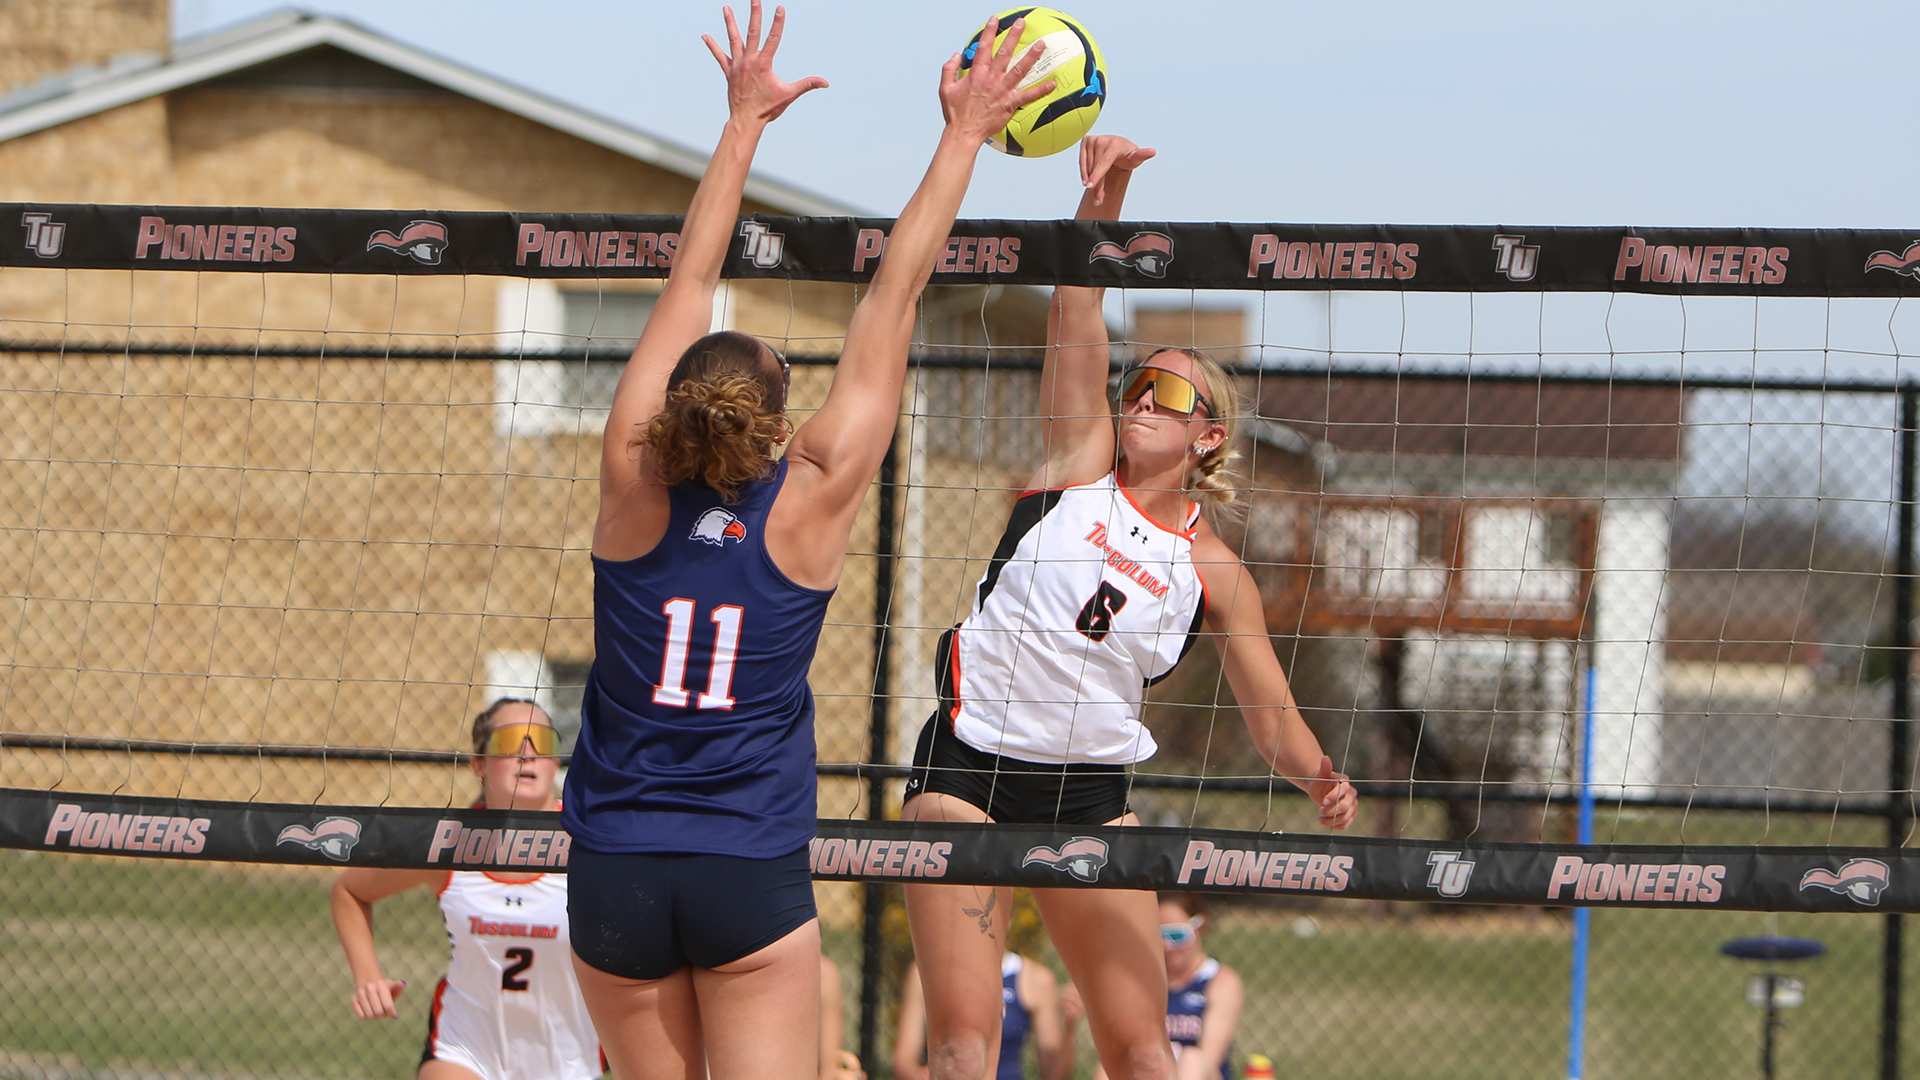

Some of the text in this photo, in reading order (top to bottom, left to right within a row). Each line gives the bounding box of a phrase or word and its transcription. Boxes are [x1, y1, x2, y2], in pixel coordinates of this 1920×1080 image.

[22, 212, 66, 258] TU
[135, 216, 297, 262] PIONEERS
[516, 223, 680, 268] PIONEERS
[740, 221, 785, 269] TU
[853, 228, 1021, 273] PEERS
[1247, 233, 1419, 280] PIONEERS
[1492, 234, 1541, 282] TU
[1614, 236, 1790, 284] PIONEERS
[1075, 580, 1128, 642] 6
[652, 597, 745, 711] 11
[44, 804, 211, 854] PIONEERS
[427, 819, 572, 866] PIONEER
[809, 836, 953, 878] IONEERS
[1177, 840, 1354, 891] PIONEERS
[1426, 850, 1476, 898] TU
[1547, 856, 1726, 902] PIONEERS
[468, 915, 559, 940] TUSCULUM
[502, 946, 534, 991] 2
